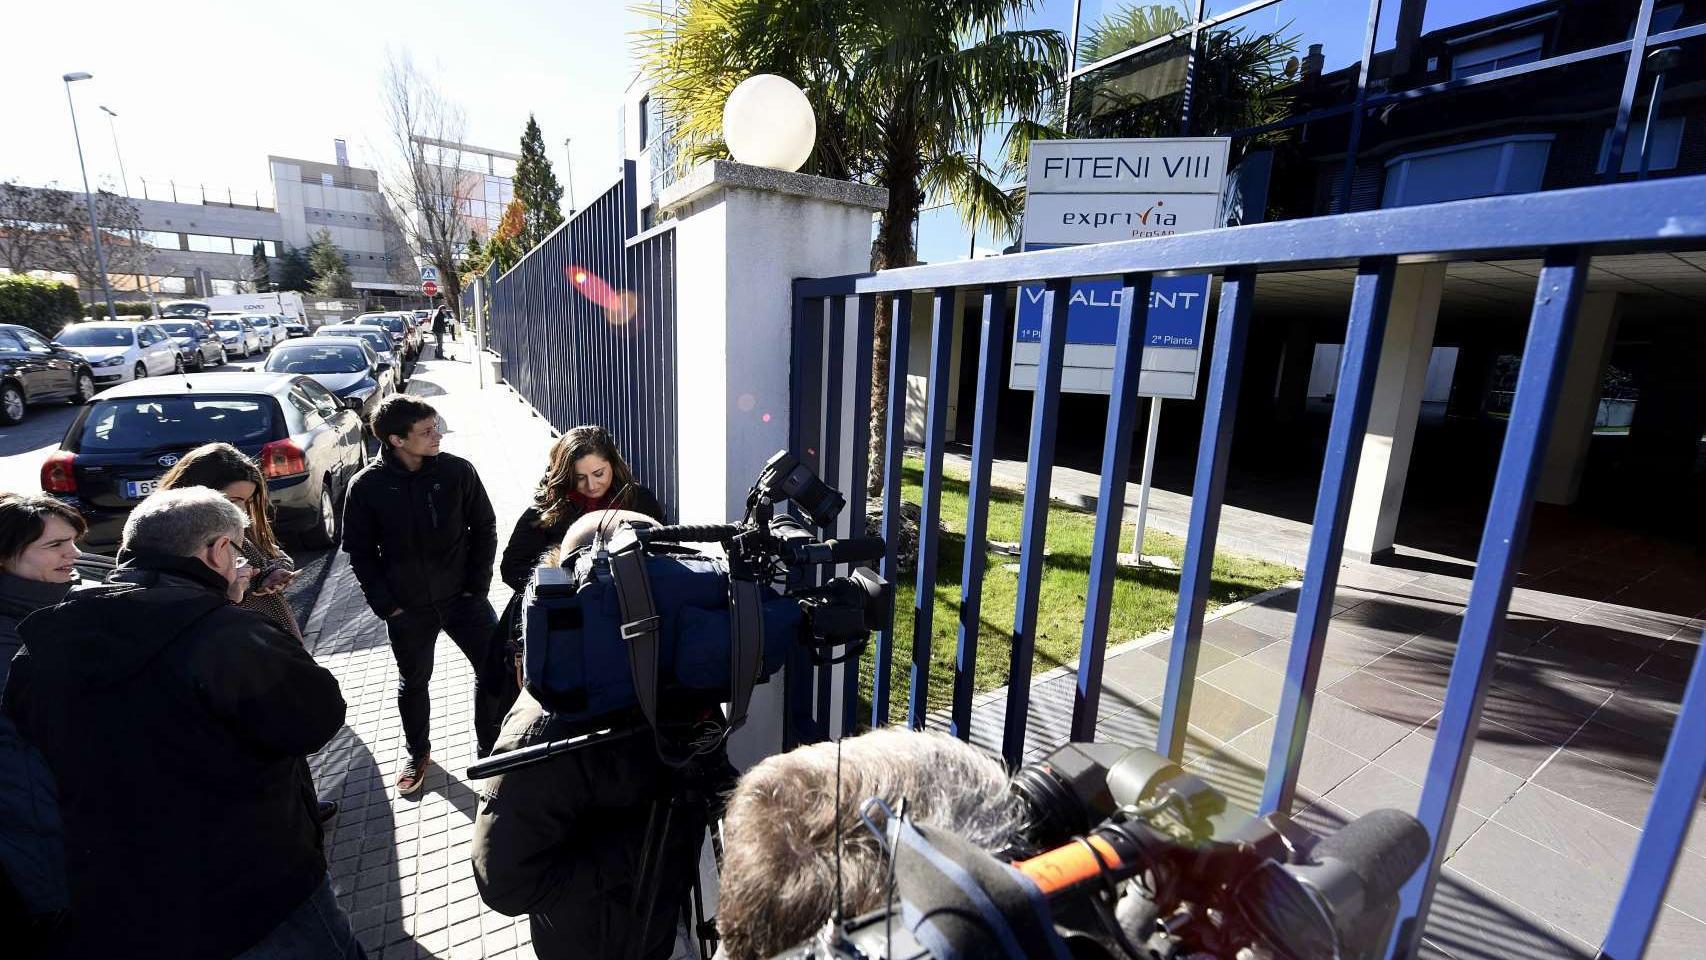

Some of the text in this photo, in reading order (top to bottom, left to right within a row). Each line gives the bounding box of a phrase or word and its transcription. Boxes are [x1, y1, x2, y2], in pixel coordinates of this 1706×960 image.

[1044, 156, 1210, 179] FITENI VIII
[1062, 201, 1177, 228] exprivia
[1025, 287, 1200, 310] VALDNT
[1163, 335, 1193, 345] Planta
